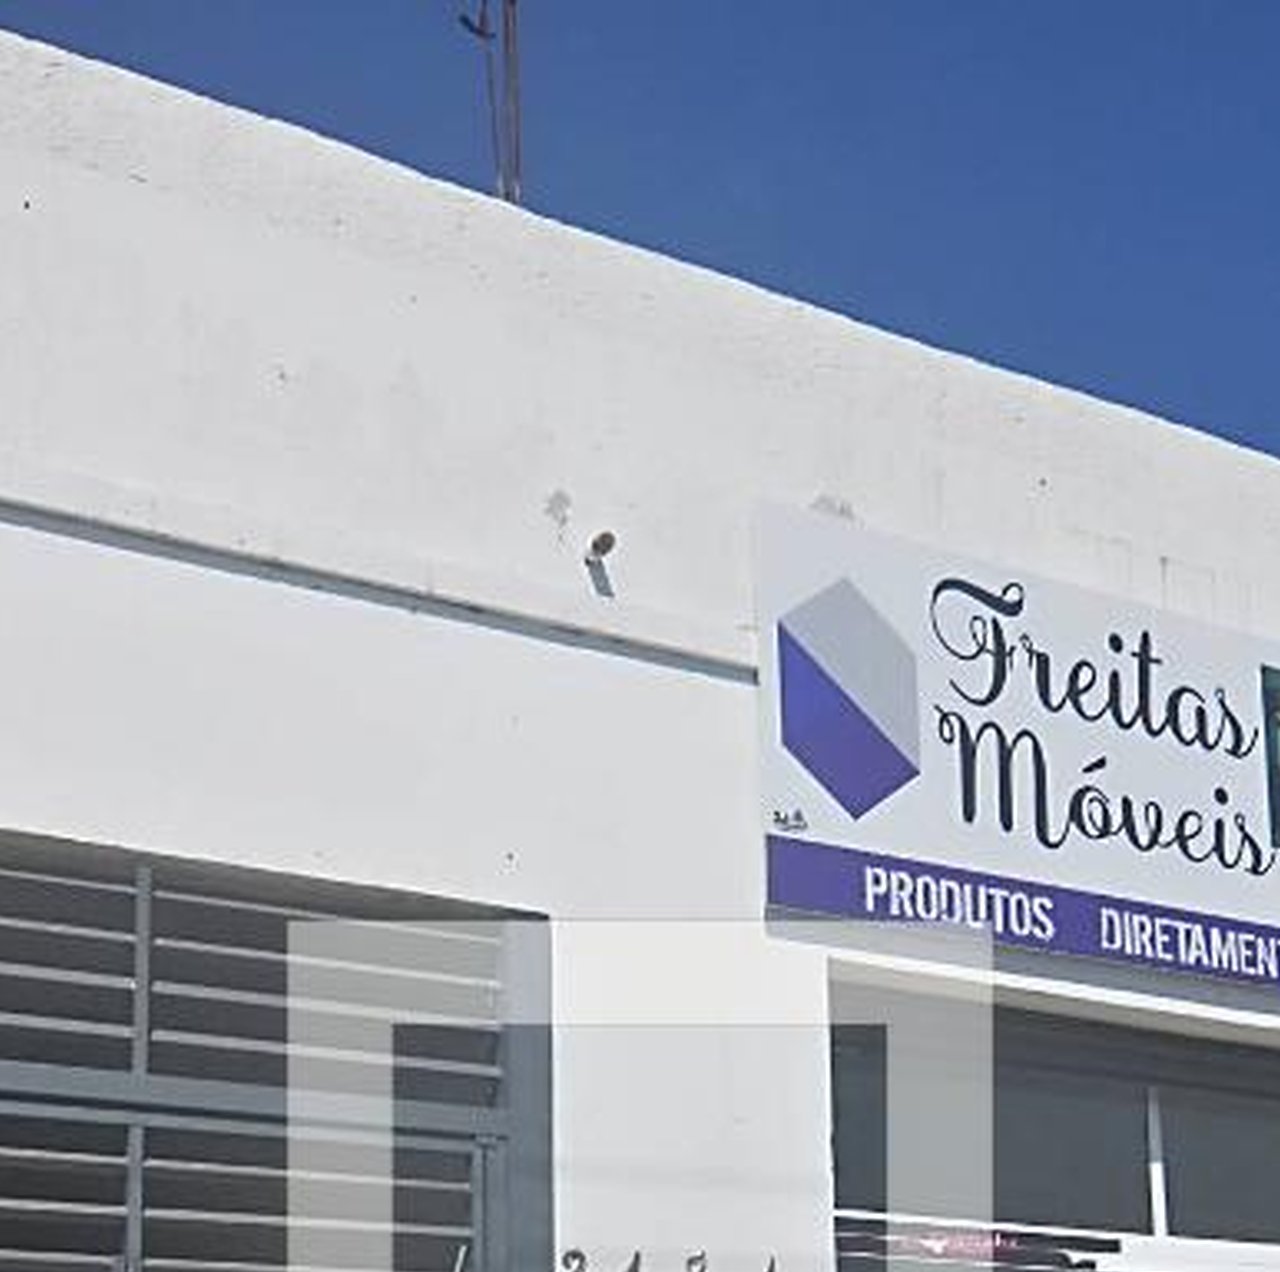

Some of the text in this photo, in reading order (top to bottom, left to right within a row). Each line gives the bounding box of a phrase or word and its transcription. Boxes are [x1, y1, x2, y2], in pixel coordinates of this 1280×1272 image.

[929, 577, 1260, 760] Freitas
[935, 704, 1276, 876] Móveis
[864, 865, 1055, 941] PRODUTOS
